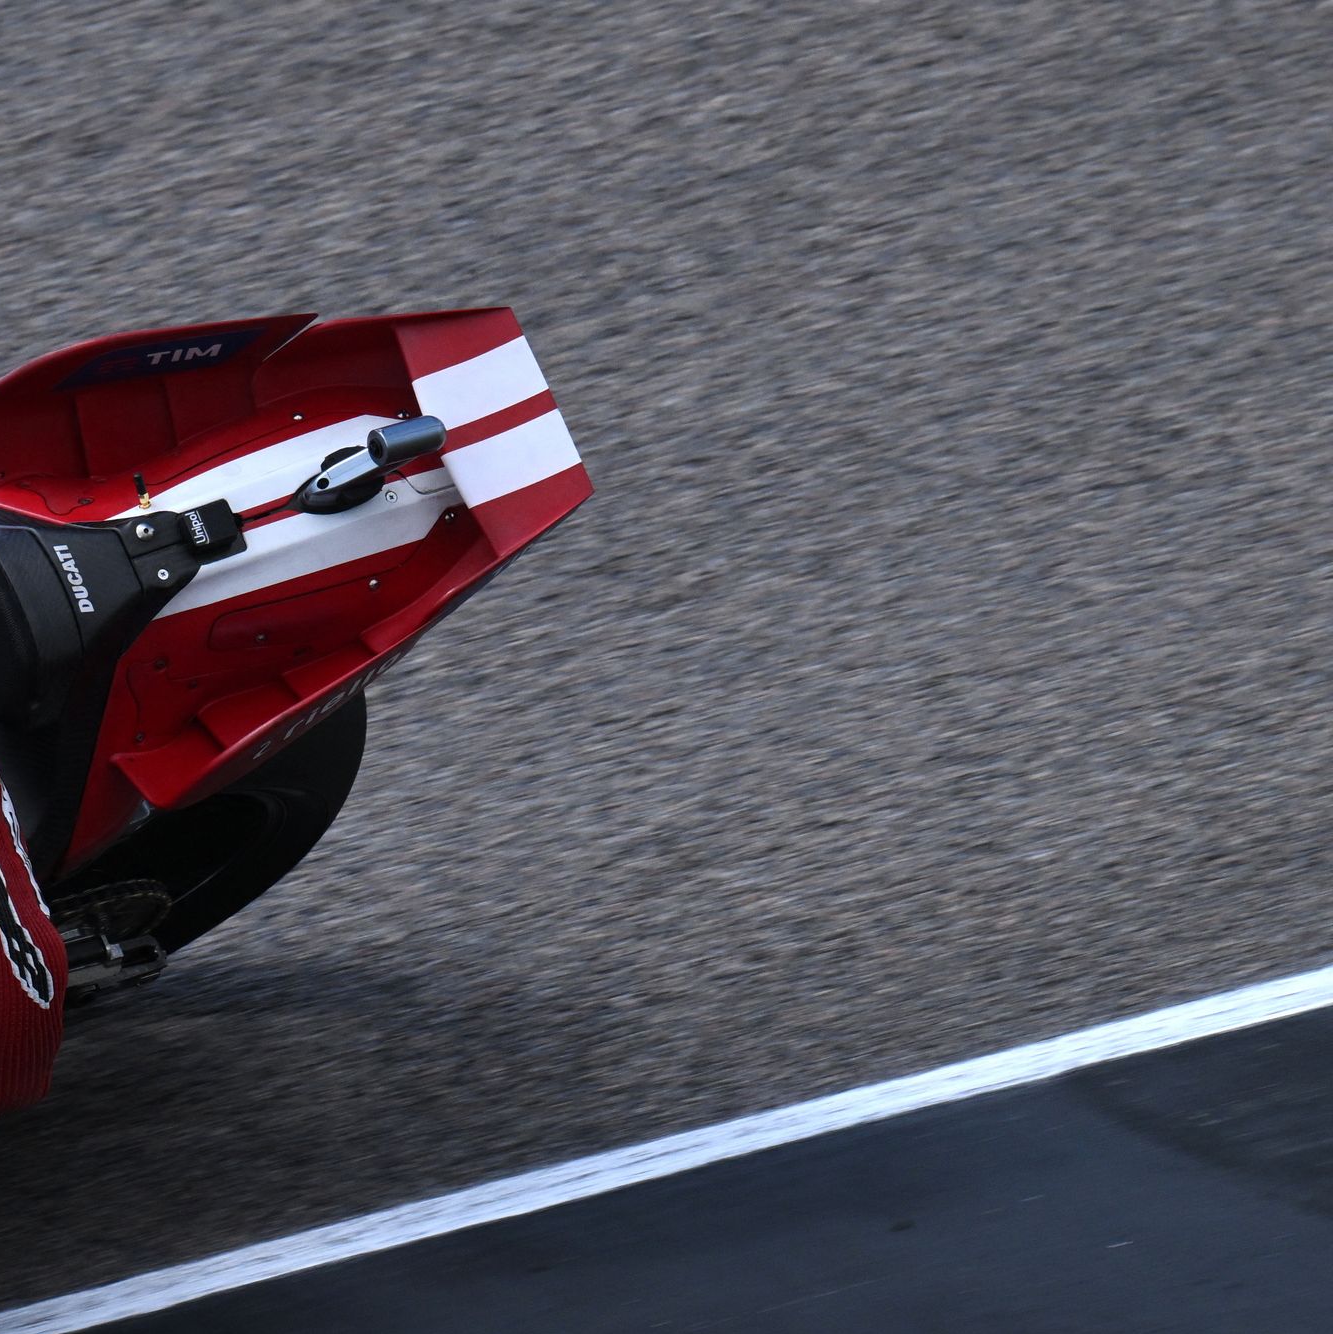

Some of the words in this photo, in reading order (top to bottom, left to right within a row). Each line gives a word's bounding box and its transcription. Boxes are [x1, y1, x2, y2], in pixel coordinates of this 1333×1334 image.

[146, 343, 222, 366] TIM
[185, 511, 206, 544] Unipol
[53, 544, 95, 613] DUCATI
